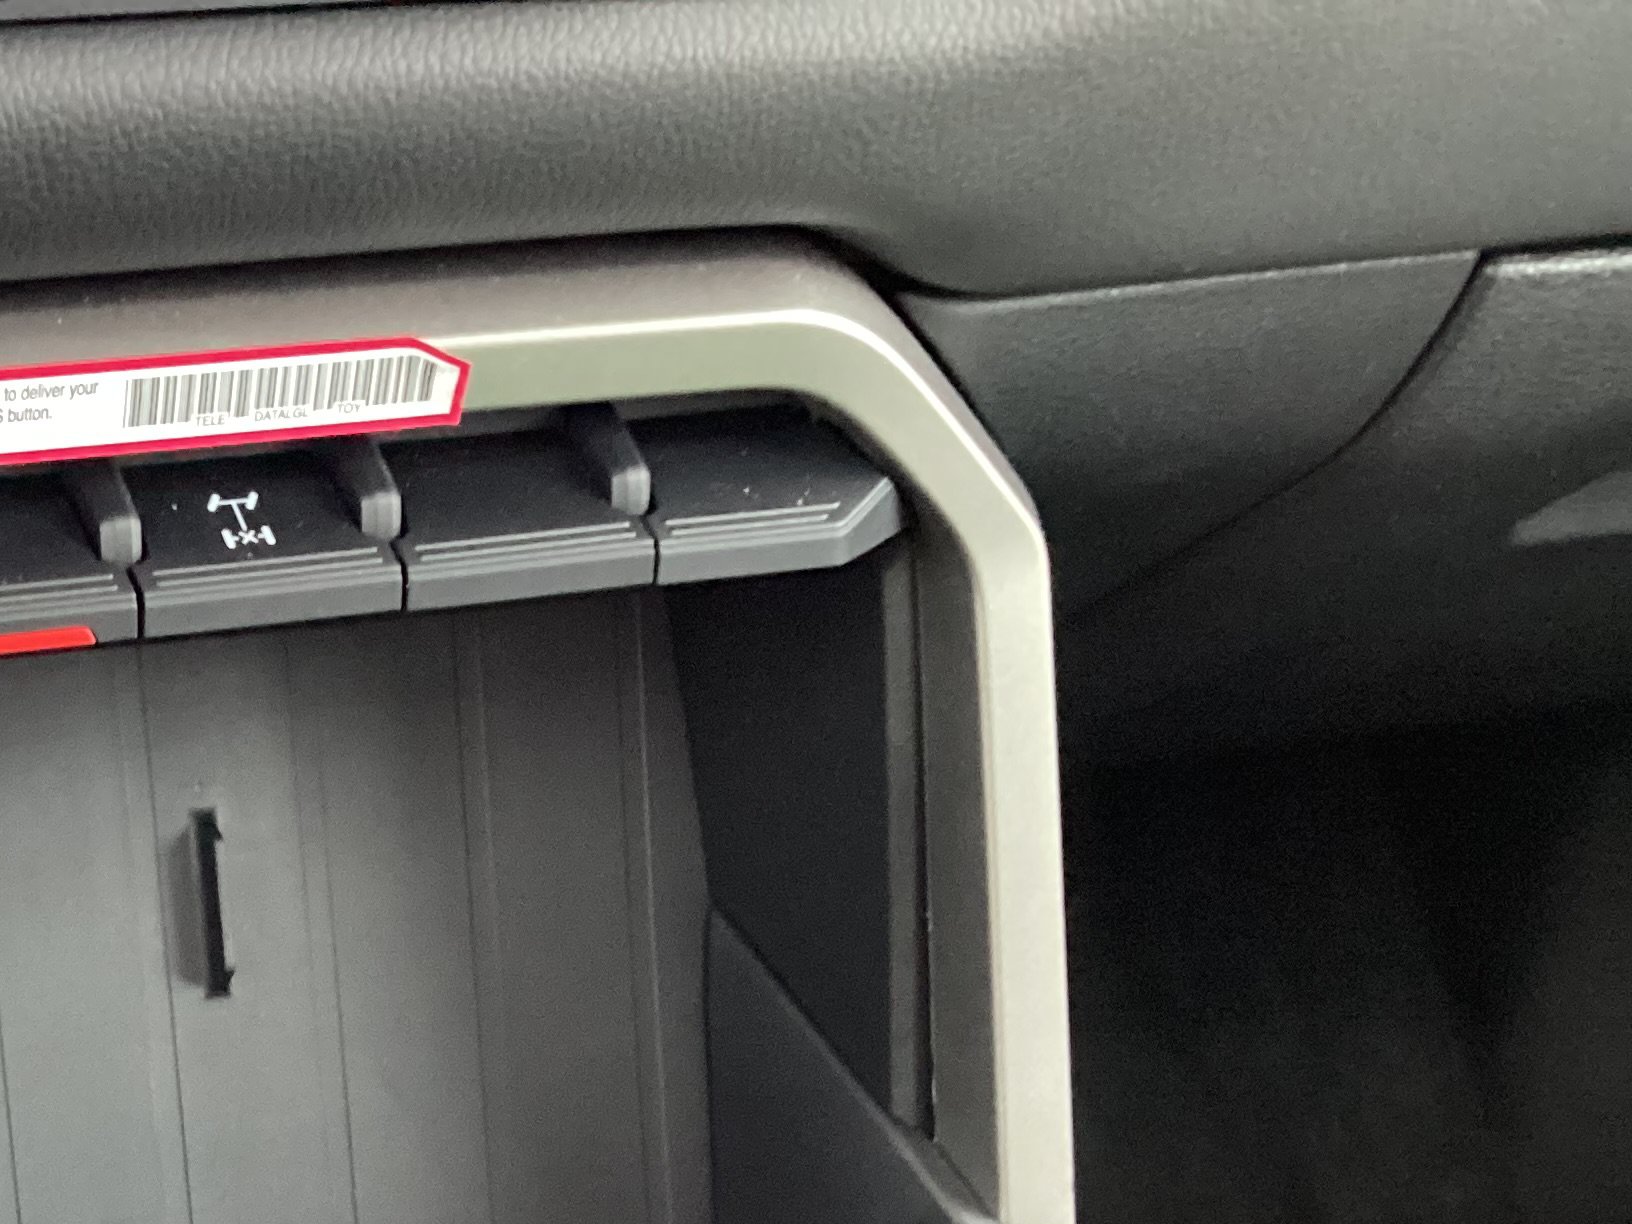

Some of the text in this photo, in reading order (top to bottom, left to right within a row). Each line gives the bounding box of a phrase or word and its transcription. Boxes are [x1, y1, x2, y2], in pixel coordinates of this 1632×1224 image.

[4, 387, 17, 402] to
[20, 383, 66, 400] deliver
[69, 381, 99, 400] your
[7, 406, 53, 424] button.
